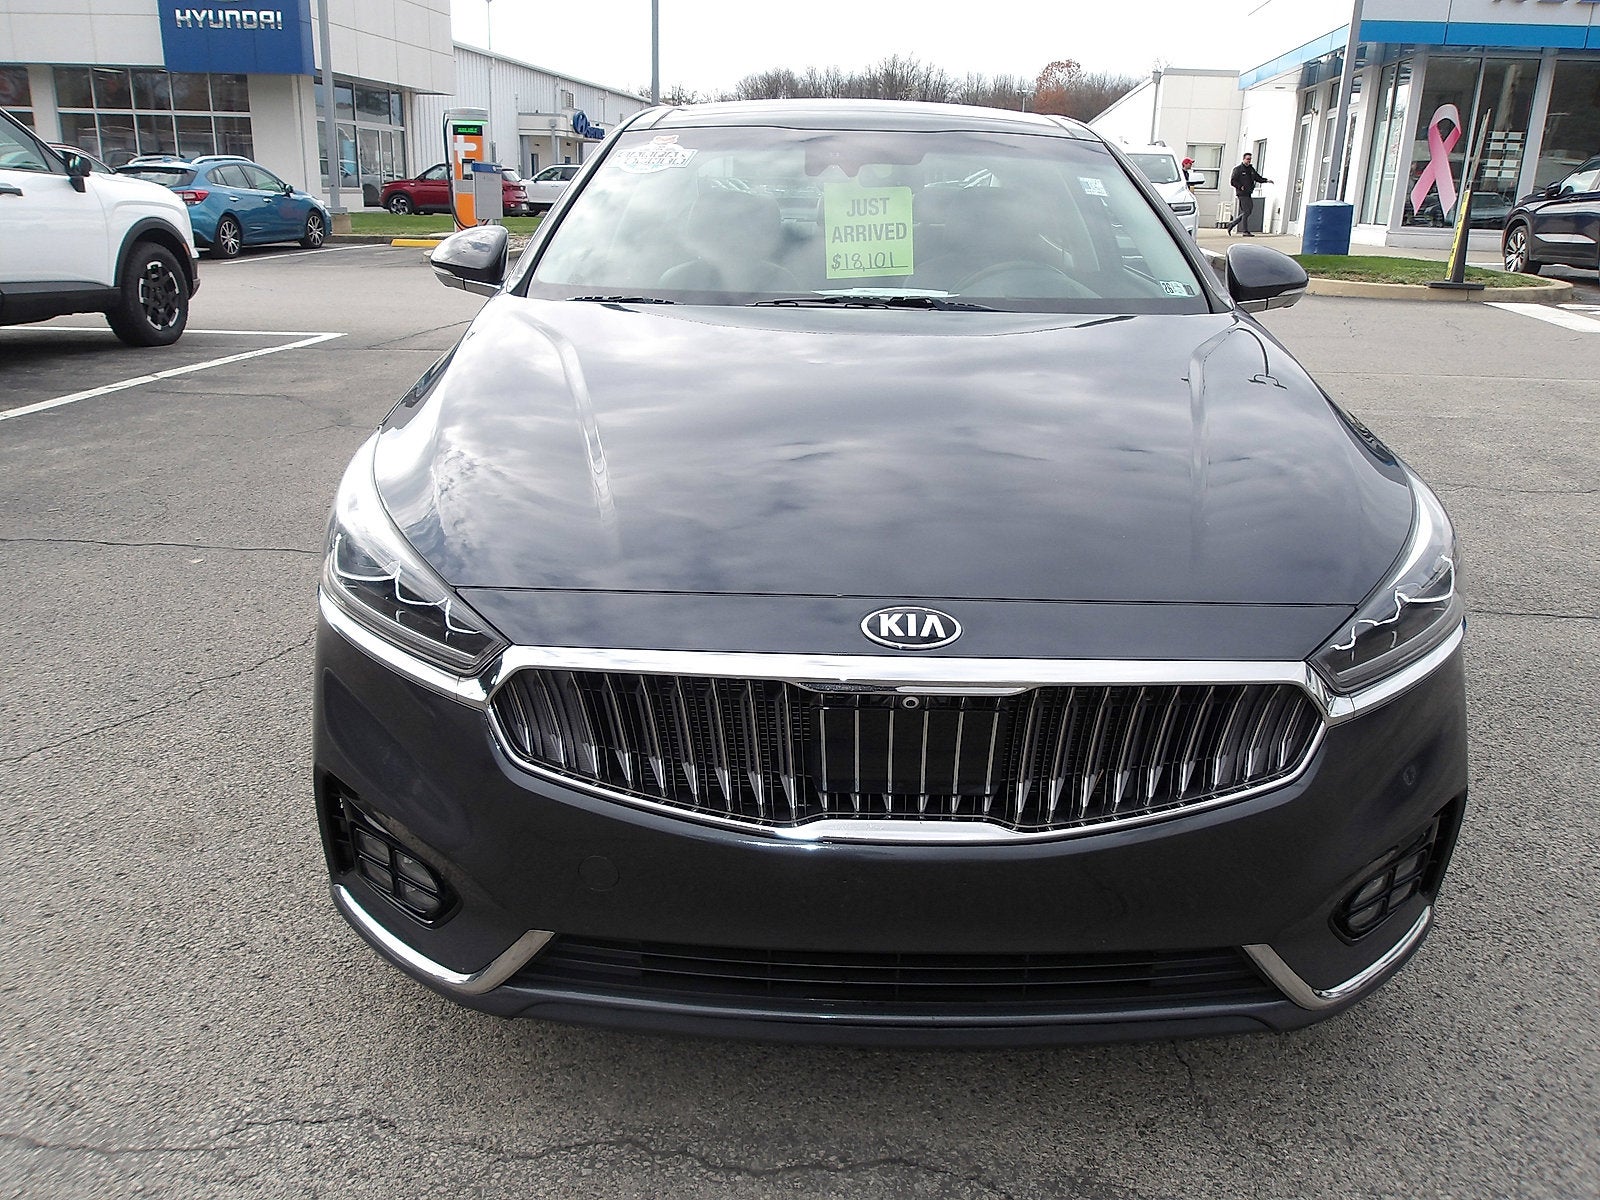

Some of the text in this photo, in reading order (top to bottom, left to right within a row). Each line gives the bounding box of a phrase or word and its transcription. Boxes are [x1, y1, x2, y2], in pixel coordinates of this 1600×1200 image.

[175, 9, 282, 30] HYUNDAI
[847, 197, 890, 217] JUST
[832, 222, 907, 243] ARRIVED
[831, 251, 894, 272] $18,101
[878, 613, 946, 638] KIA
